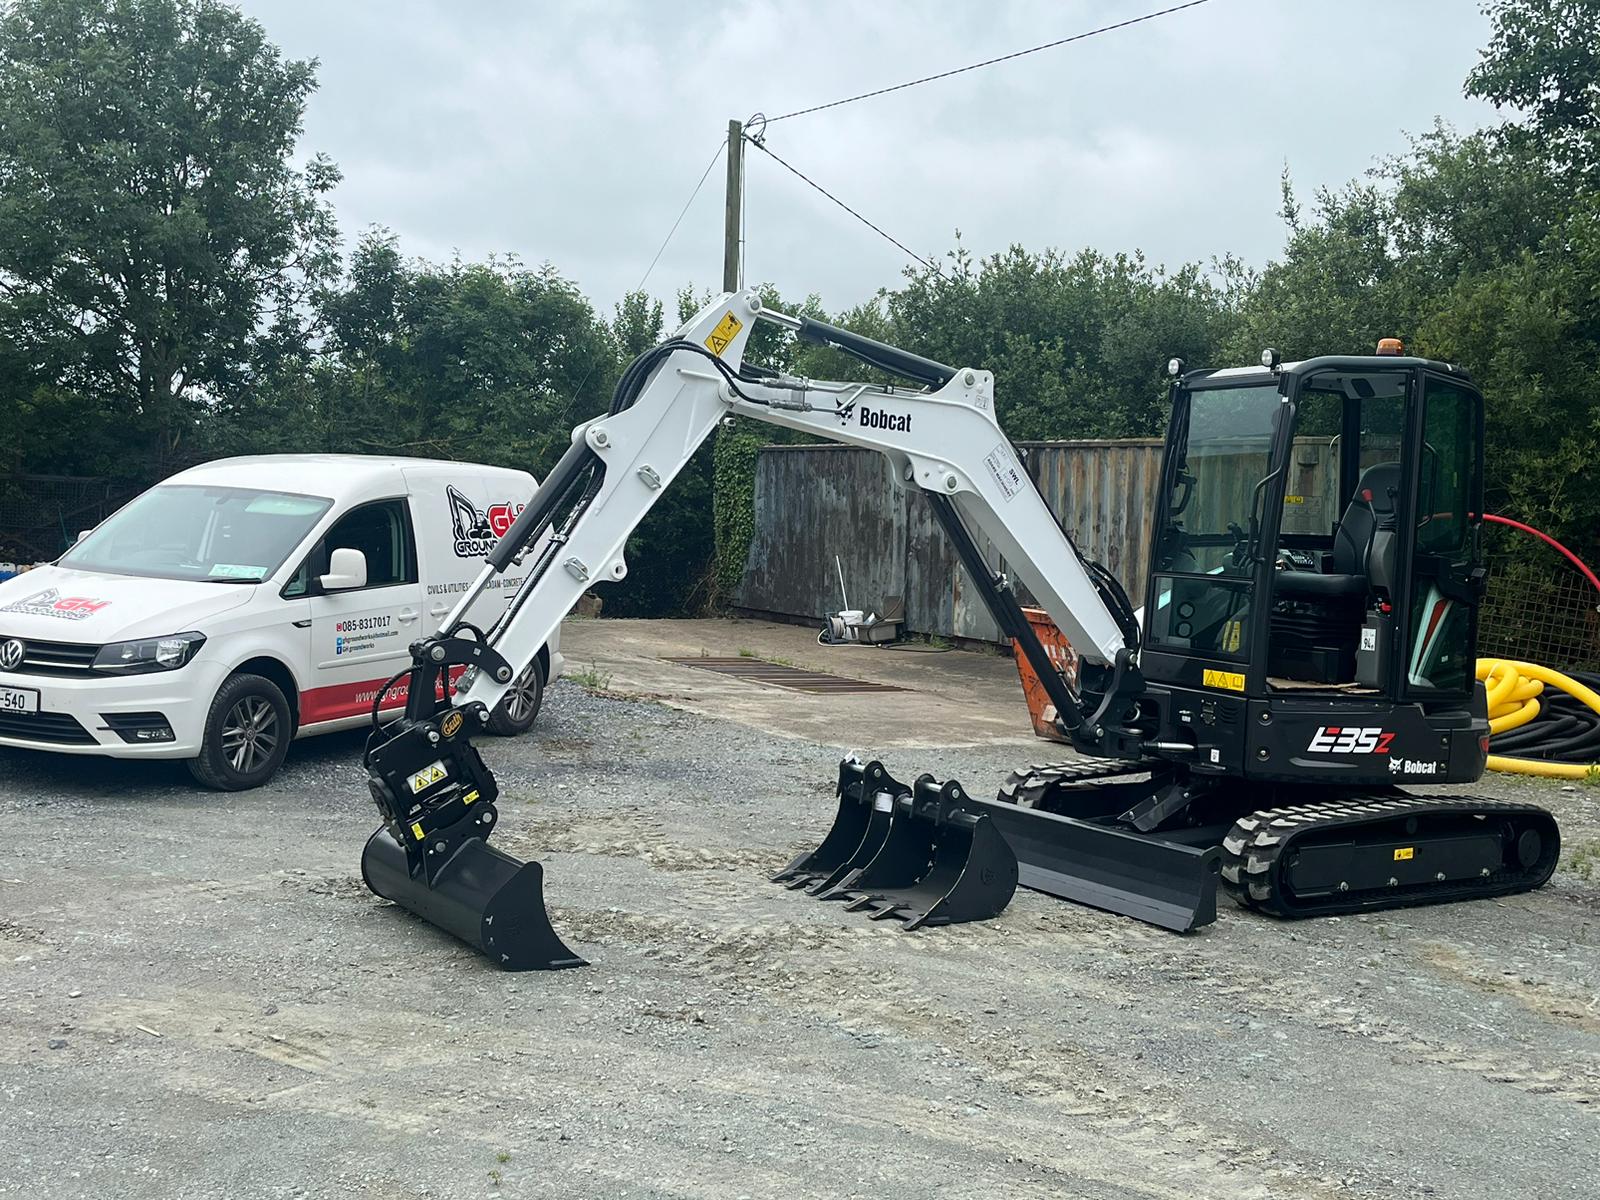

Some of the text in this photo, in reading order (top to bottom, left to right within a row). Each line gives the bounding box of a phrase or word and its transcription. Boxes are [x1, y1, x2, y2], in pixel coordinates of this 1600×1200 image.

[860, 406, 911, 432] Bobcat
[343, 616, 391, 632] 085-8317017
[1404, 760, 1437, 774] Bobcat
